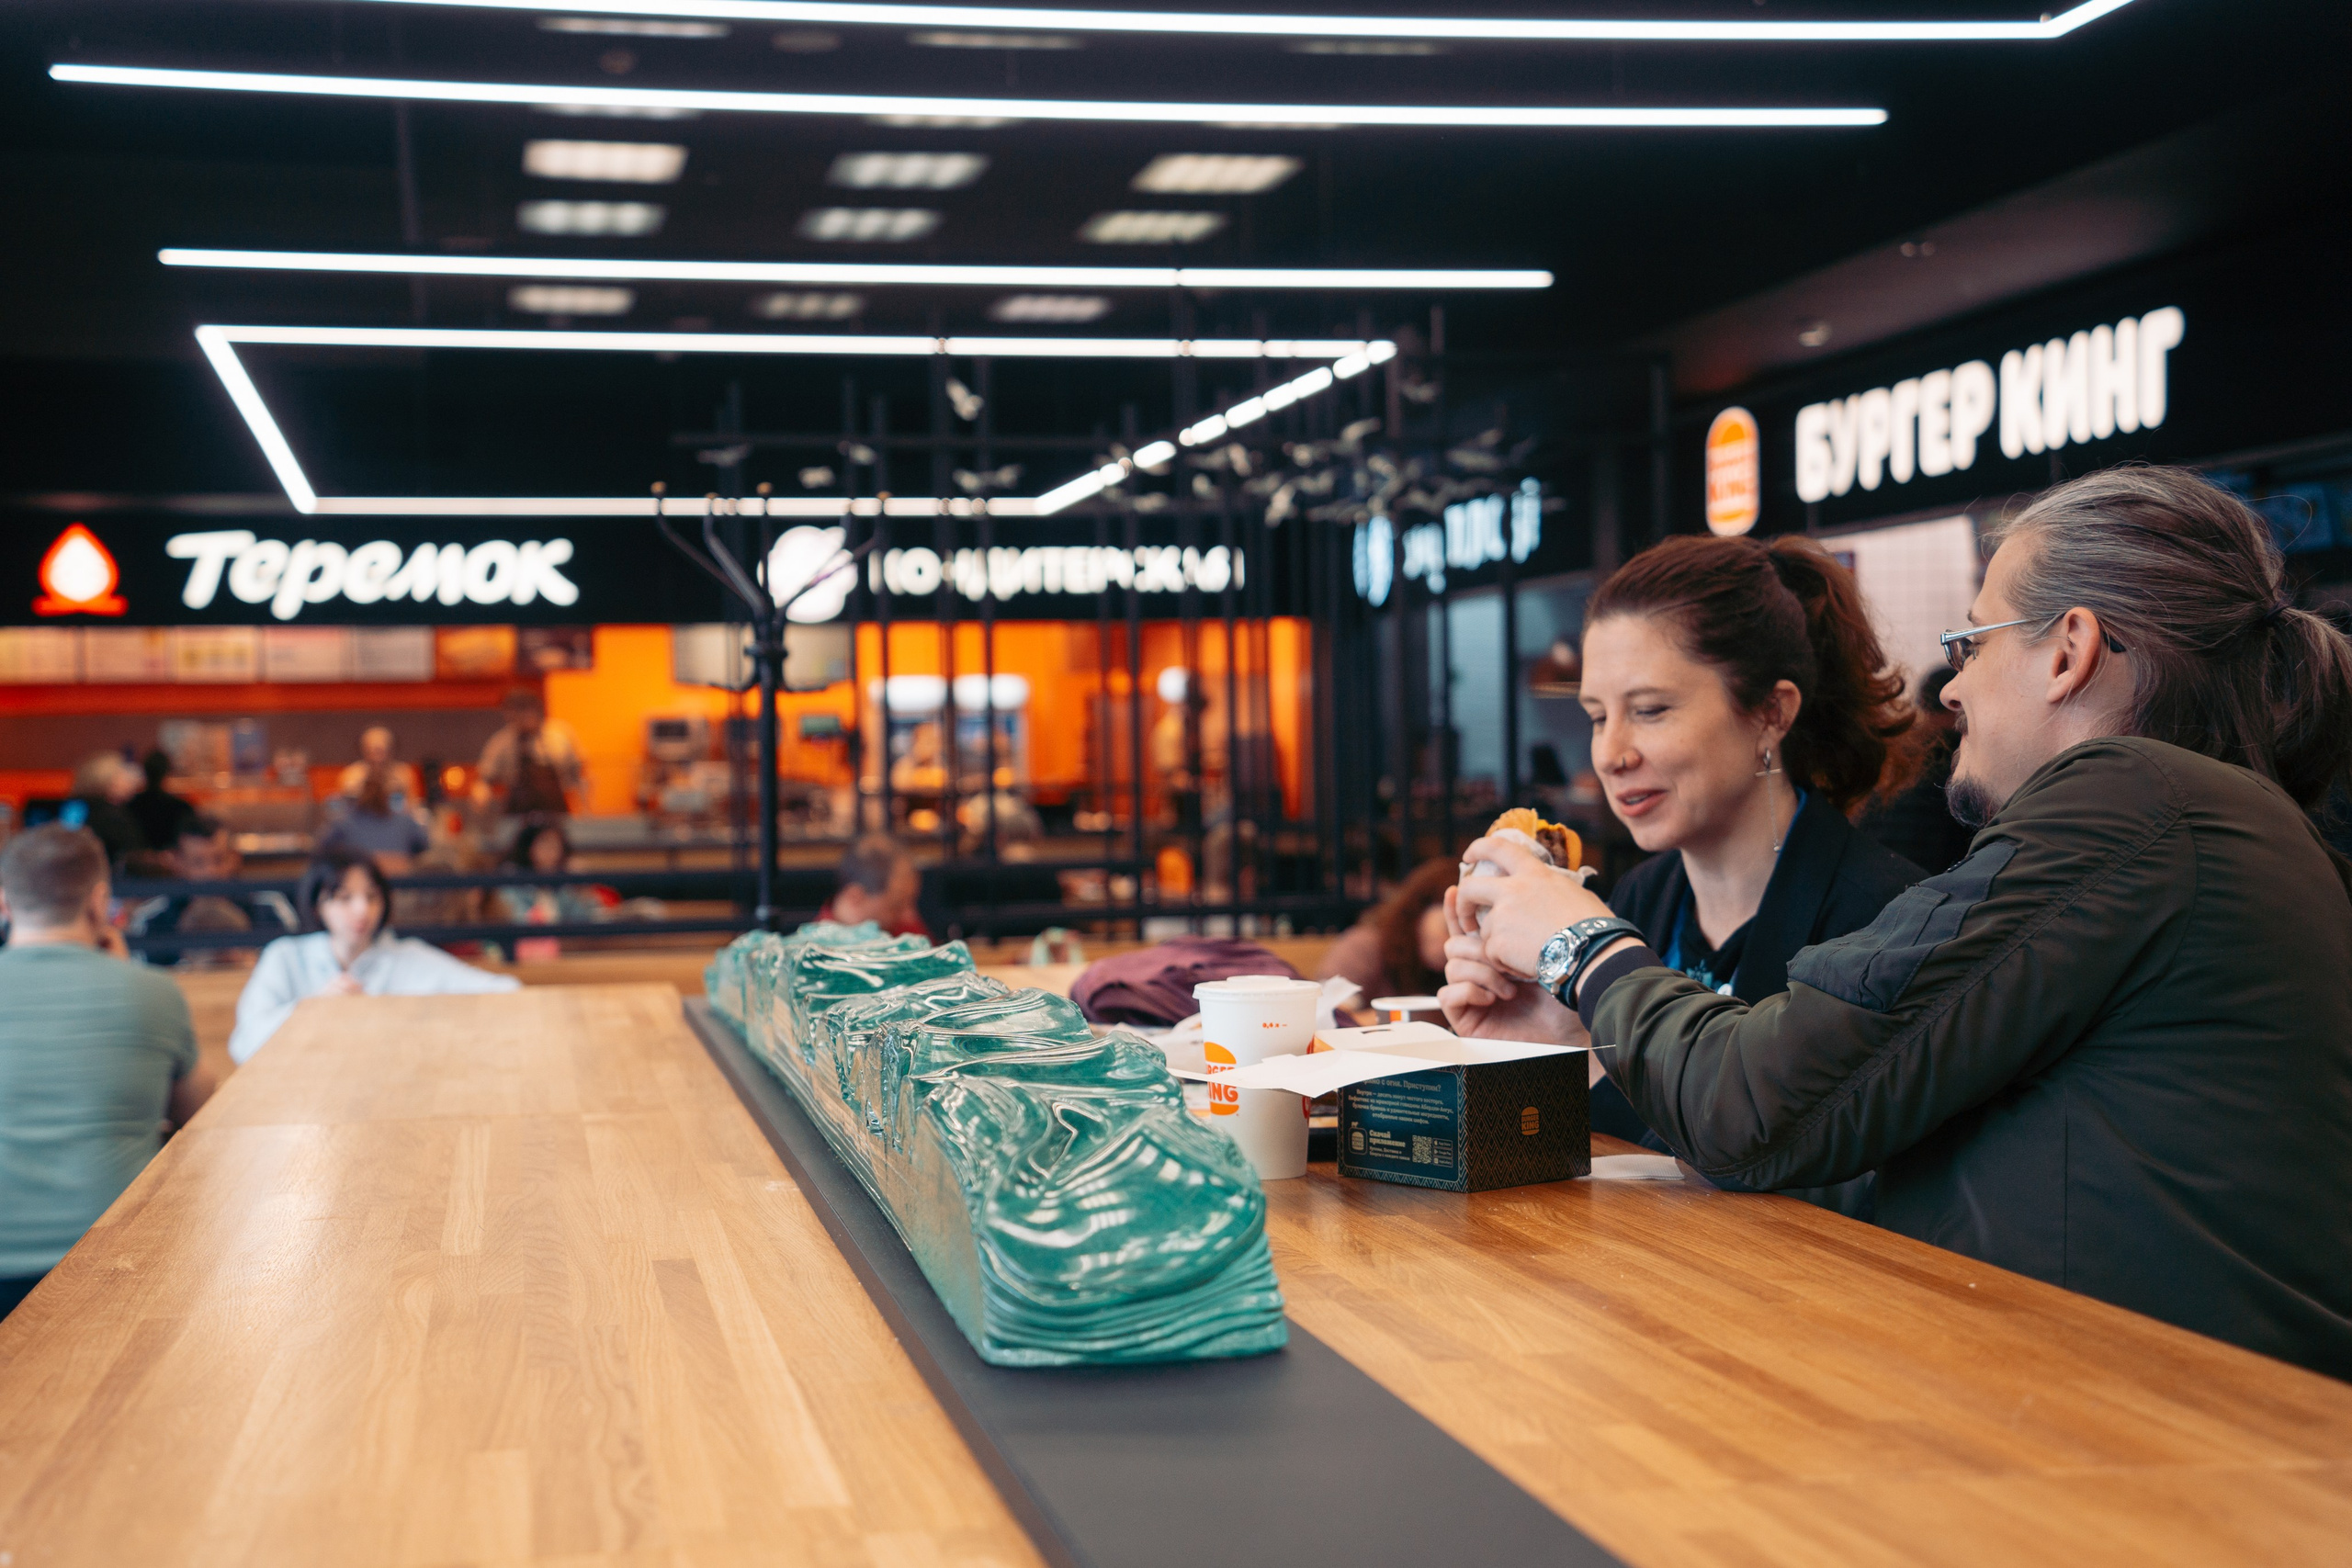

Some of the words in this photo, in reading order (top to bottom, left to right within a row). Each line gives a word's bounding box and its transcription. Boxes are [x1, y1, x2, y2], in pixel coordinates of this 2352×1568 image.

[1795, 359, 1996, 502] БУРГЕР
[1999, 306, 2185, 459] КИНГ
[165, 530, 580, 621] Теремок
[1207, 1081, 1238, 1102] ING
[1403, 1080, 1442, 1092] Приступим?
[1521, 1121, 1539, 1130] KING
[1369, 1130, 1391, 1139] Скачай
